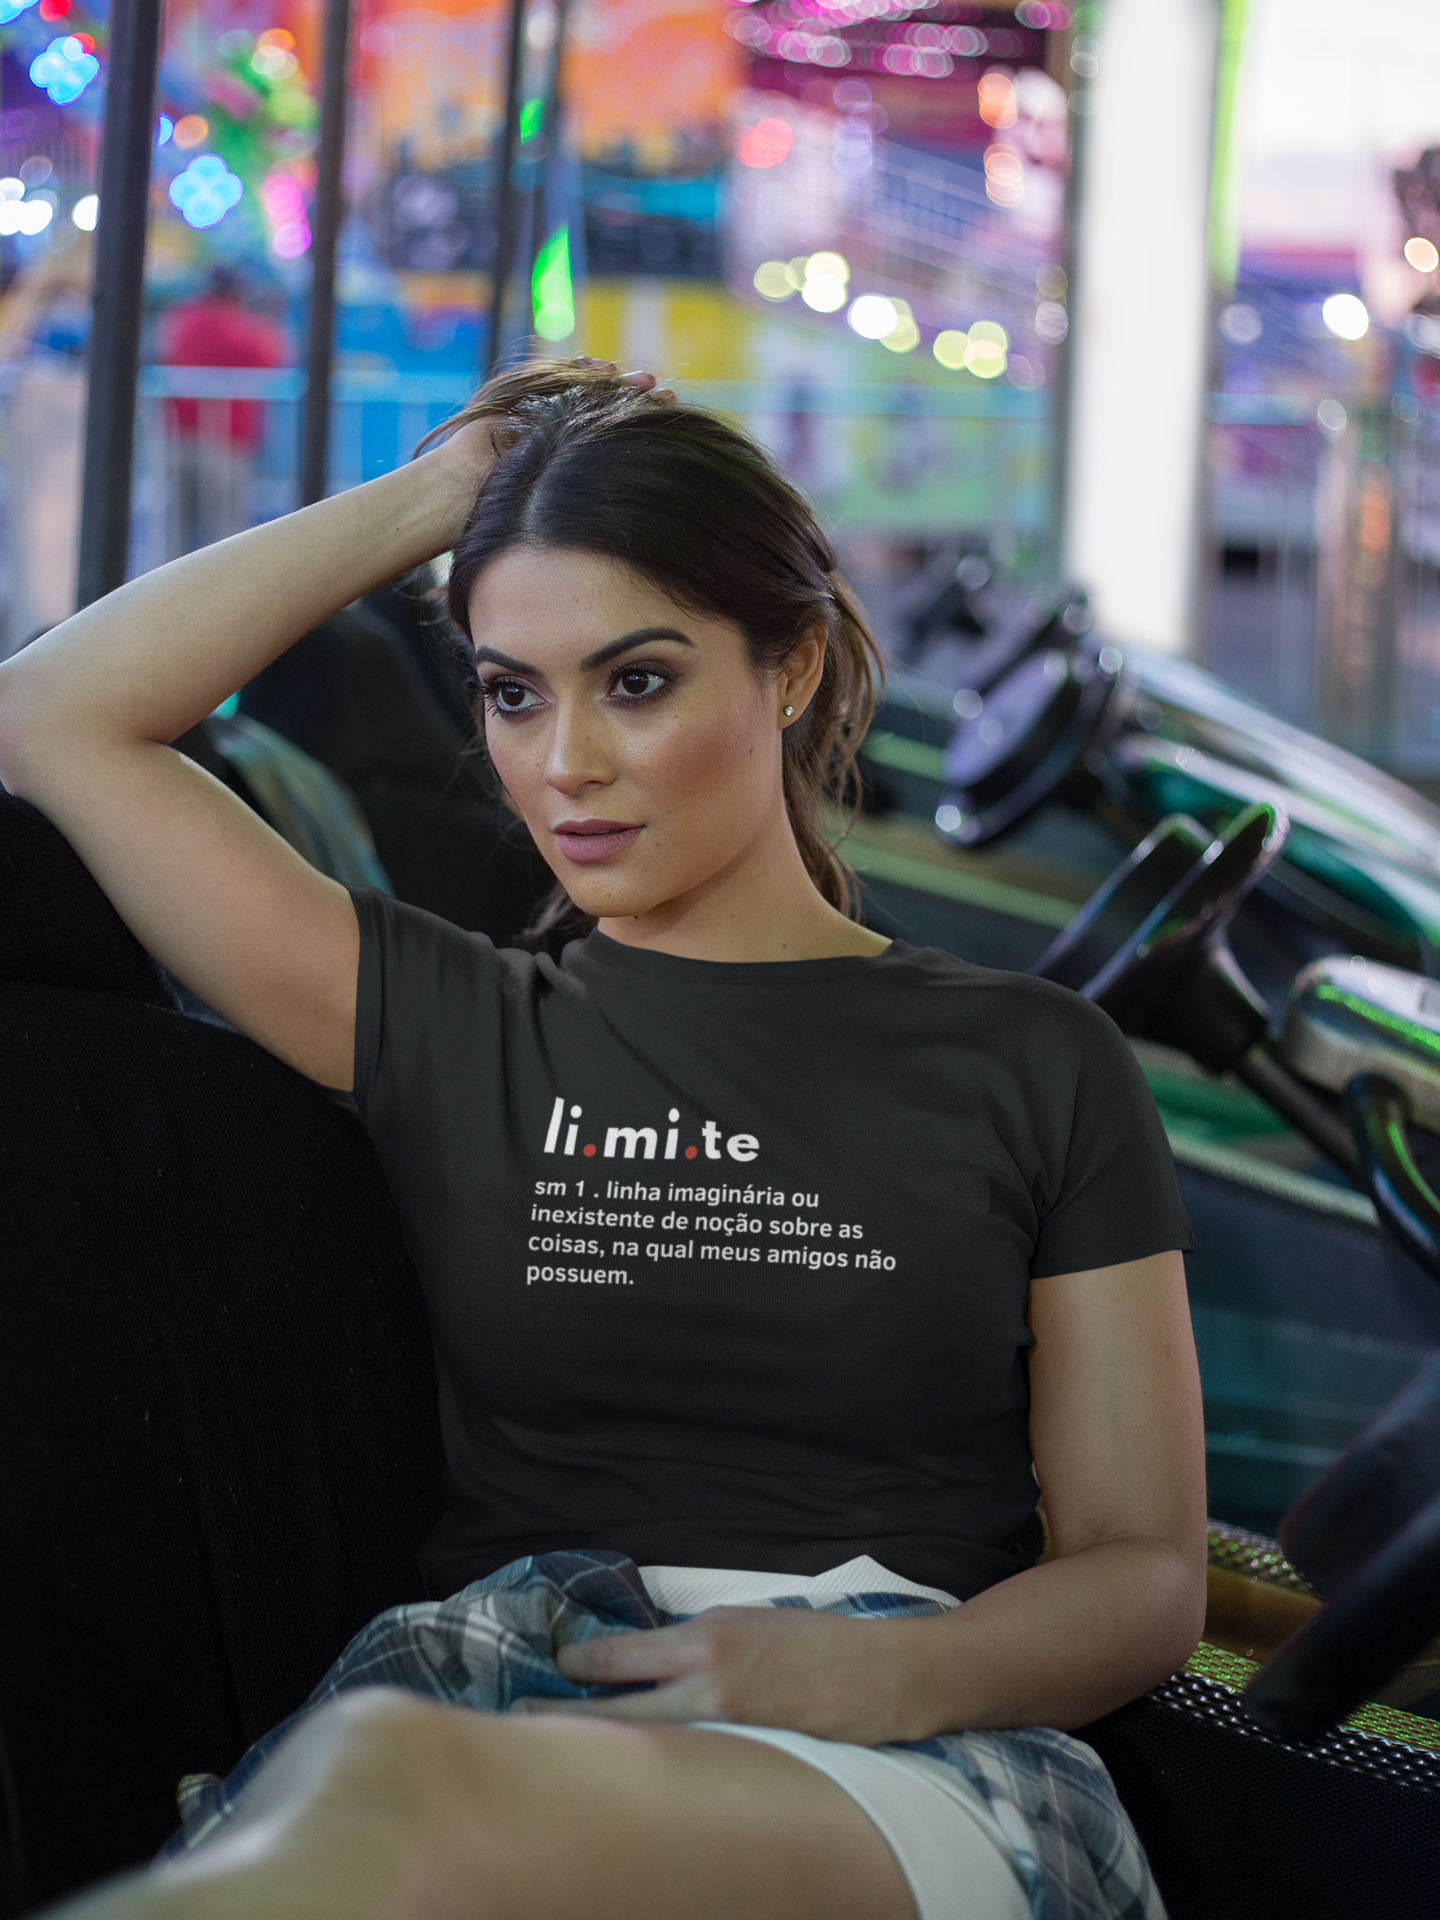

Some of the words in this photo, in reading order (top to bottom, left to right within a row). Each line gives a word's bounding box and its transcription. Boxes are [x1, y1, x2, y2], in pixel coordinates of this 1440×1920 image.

[543, 1096, 760, 1163] li.mi.te
[534, 1181, 567, 1196] sm
[606, 1180, 662, 1202] linha
[667, 1182, 785, 1207] imaginária
[791, 1192, 819, 1208] ou
[531, 1203, 655, 1229] inexistente
[661, 1210, 689, 1230] de
[694, 1212, 763, 1237] noção
[768, 1216, 833, 1238] sobre
[838, 1223, 864, 1240] as
[528, 1233, 605, 1258] coisas,
[612, 1241, 639, 1257] na
[645, 1239, 694, 1262] qual
[700, 1245, 761, 1263] meus
[766, 1245, 849, 1270] amigos
[854, 1248, 897, 1271] não
[526, 1265, 634, 1286] possuem.
